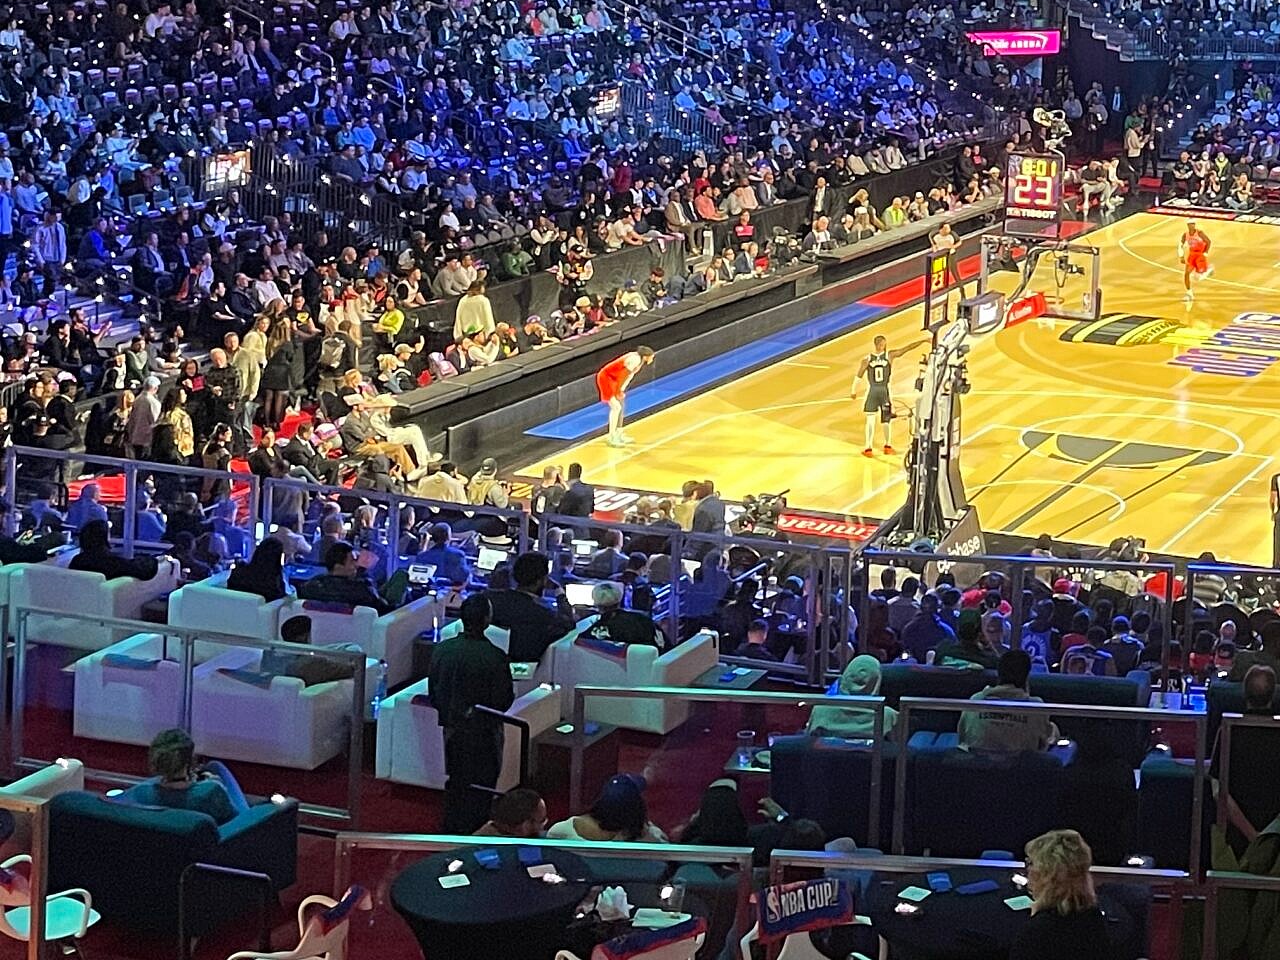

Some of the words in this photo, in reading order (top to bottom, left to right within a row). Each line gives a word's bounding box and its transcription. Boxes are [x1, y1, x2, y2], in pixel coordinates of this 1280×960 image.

[1010, 40, 1042, 49] ARENA
[1022, 159, 1057, 177] 8:01
[1015, 175, 1052, 205] 23
[1022, 209, 1057, 218] TISSOT
[875, 366, 884, 382] 0
[781, 888, 806, 918] NBA
[806, 882, 832, 911] CUP
